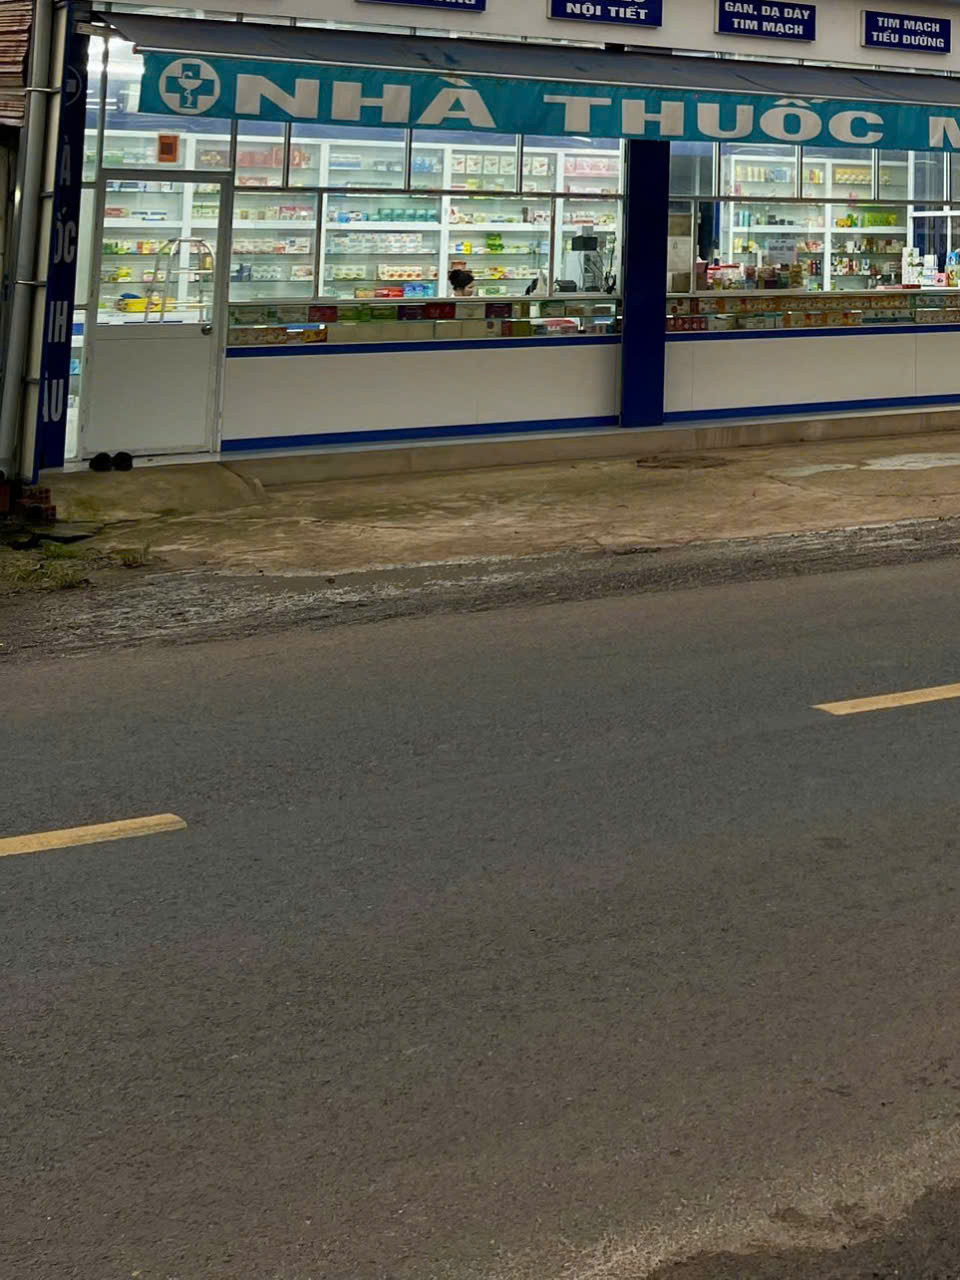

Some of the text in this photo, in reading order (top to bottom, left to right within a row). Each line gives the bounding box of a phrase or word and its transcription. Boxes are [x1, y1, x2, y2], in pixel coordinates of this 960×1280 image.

[566, 1, 648, 20] NỘI TIẾT
[732, 18, 804, 36] TIM MẠCH
[877, 16, 940, 34] TIM MẠCH
[235, 72, 497, 130] NHÀ
[543, 94, 885, 144] THUỐC
